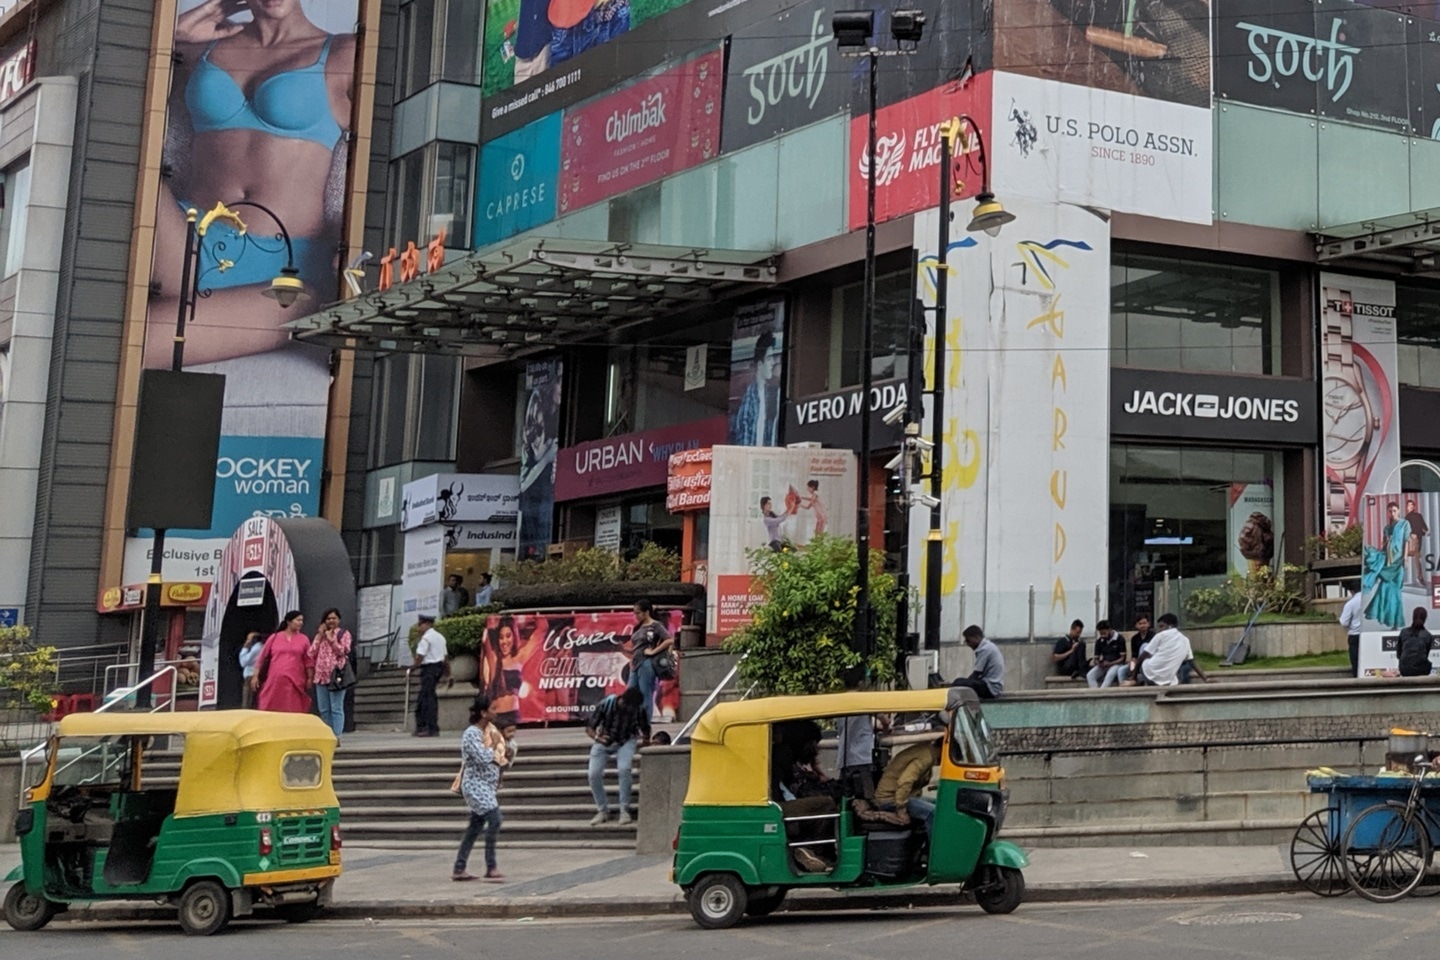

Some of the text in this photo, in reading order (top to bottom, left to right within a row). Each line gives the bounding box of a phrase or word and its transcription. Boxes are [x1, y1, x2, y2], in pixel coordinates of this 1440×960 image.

[741, 8, 834, 125] soch
[1235, 17, 1361, 103] soch
[0, 47, 28, 104] FC
[508, 94, 528, 111] missed
[567, 69, 581, 87] 1111
[606, 92, 667, 142] Chumbak
[1046, 115, 1198, 157] U.S. POLO ASSN.
[909, 130, 983, 172] MACINE
[1091, 146, 1155, 167] SINCE 1890
[597, 171, 611, 184] FIND
[486, 182, 545, 220] CAPRESE
[1355, 304, 1394, 317] TISSOT
[796, 382, 908, 425] VERO MODA
[1124, 390, 1299, 422] JACK JONES
[575, 439, 644, 474] URBAN
[216, 457, 312, 478] OCKEY
[235, 479, 309, 494] woman
[679, 491, 711, 505] Barod
[248, 519, 263, 537] SALE
[467, 530, 512, 540] IndusInd
[147, 548, 209, 561] Eclusive
[194, 566, 214, 576] 1st
[564, 628, 621, 650] Senza
[539, 676, 618, 690] NIGHT OUT
[546, 705, 579, 713] GROUND
